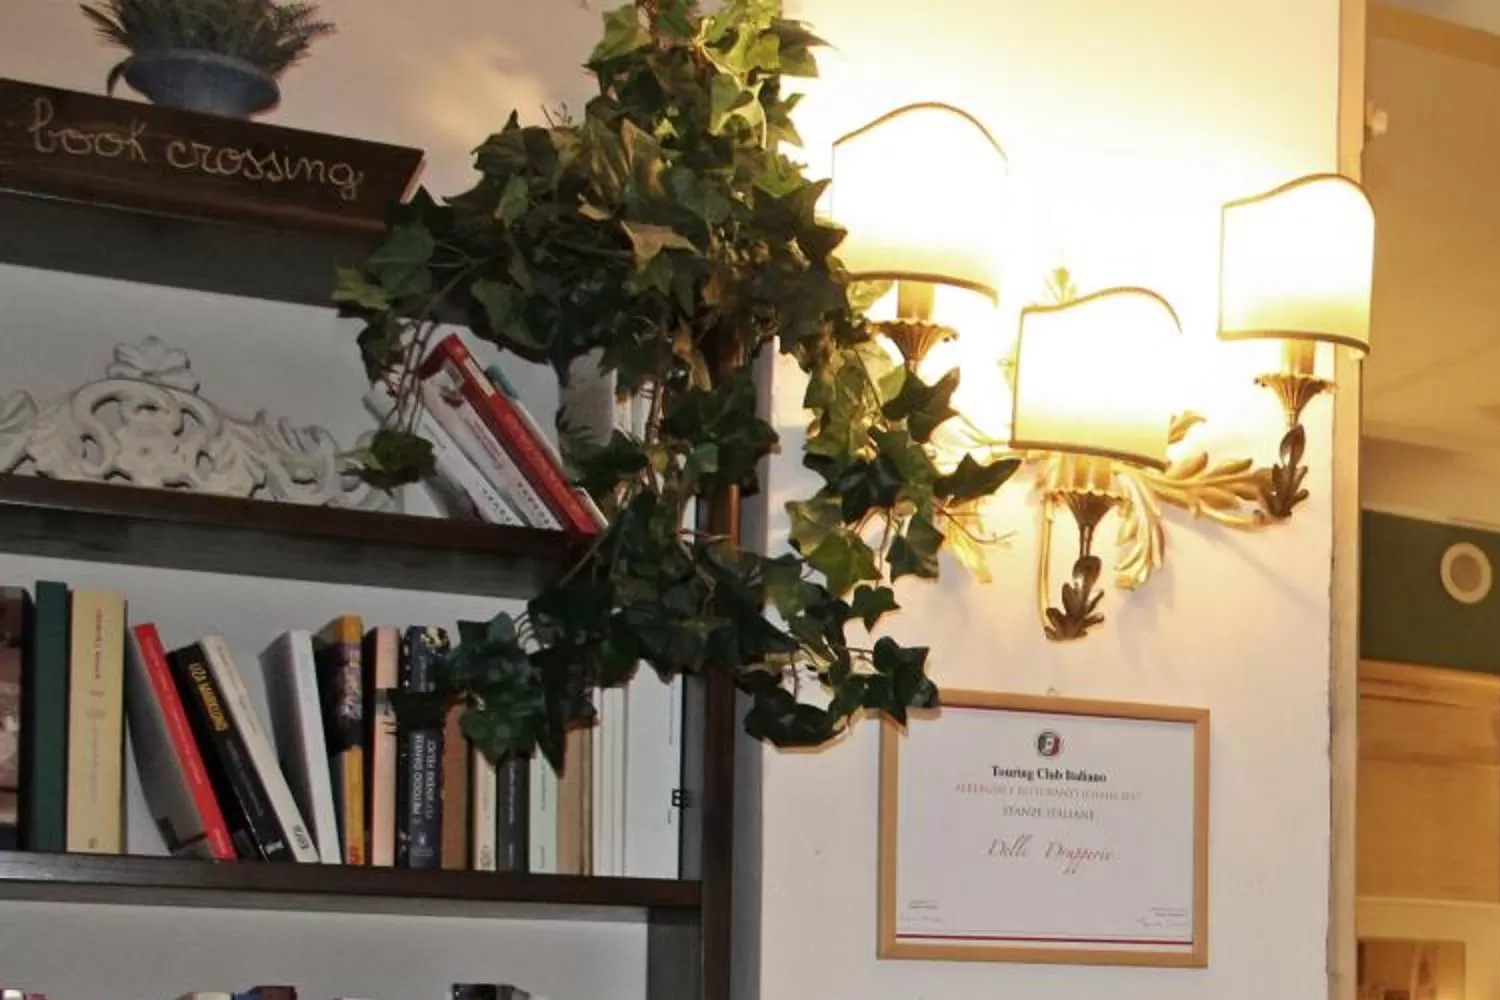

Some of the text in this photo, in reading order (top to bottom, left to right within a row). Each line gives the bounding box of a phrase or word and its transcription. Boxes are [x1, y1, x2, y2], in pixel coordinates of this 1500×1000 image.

[28, 101, 365, 199] book crossing
[992, 765, 1107, 782] Touring Club Italiano
